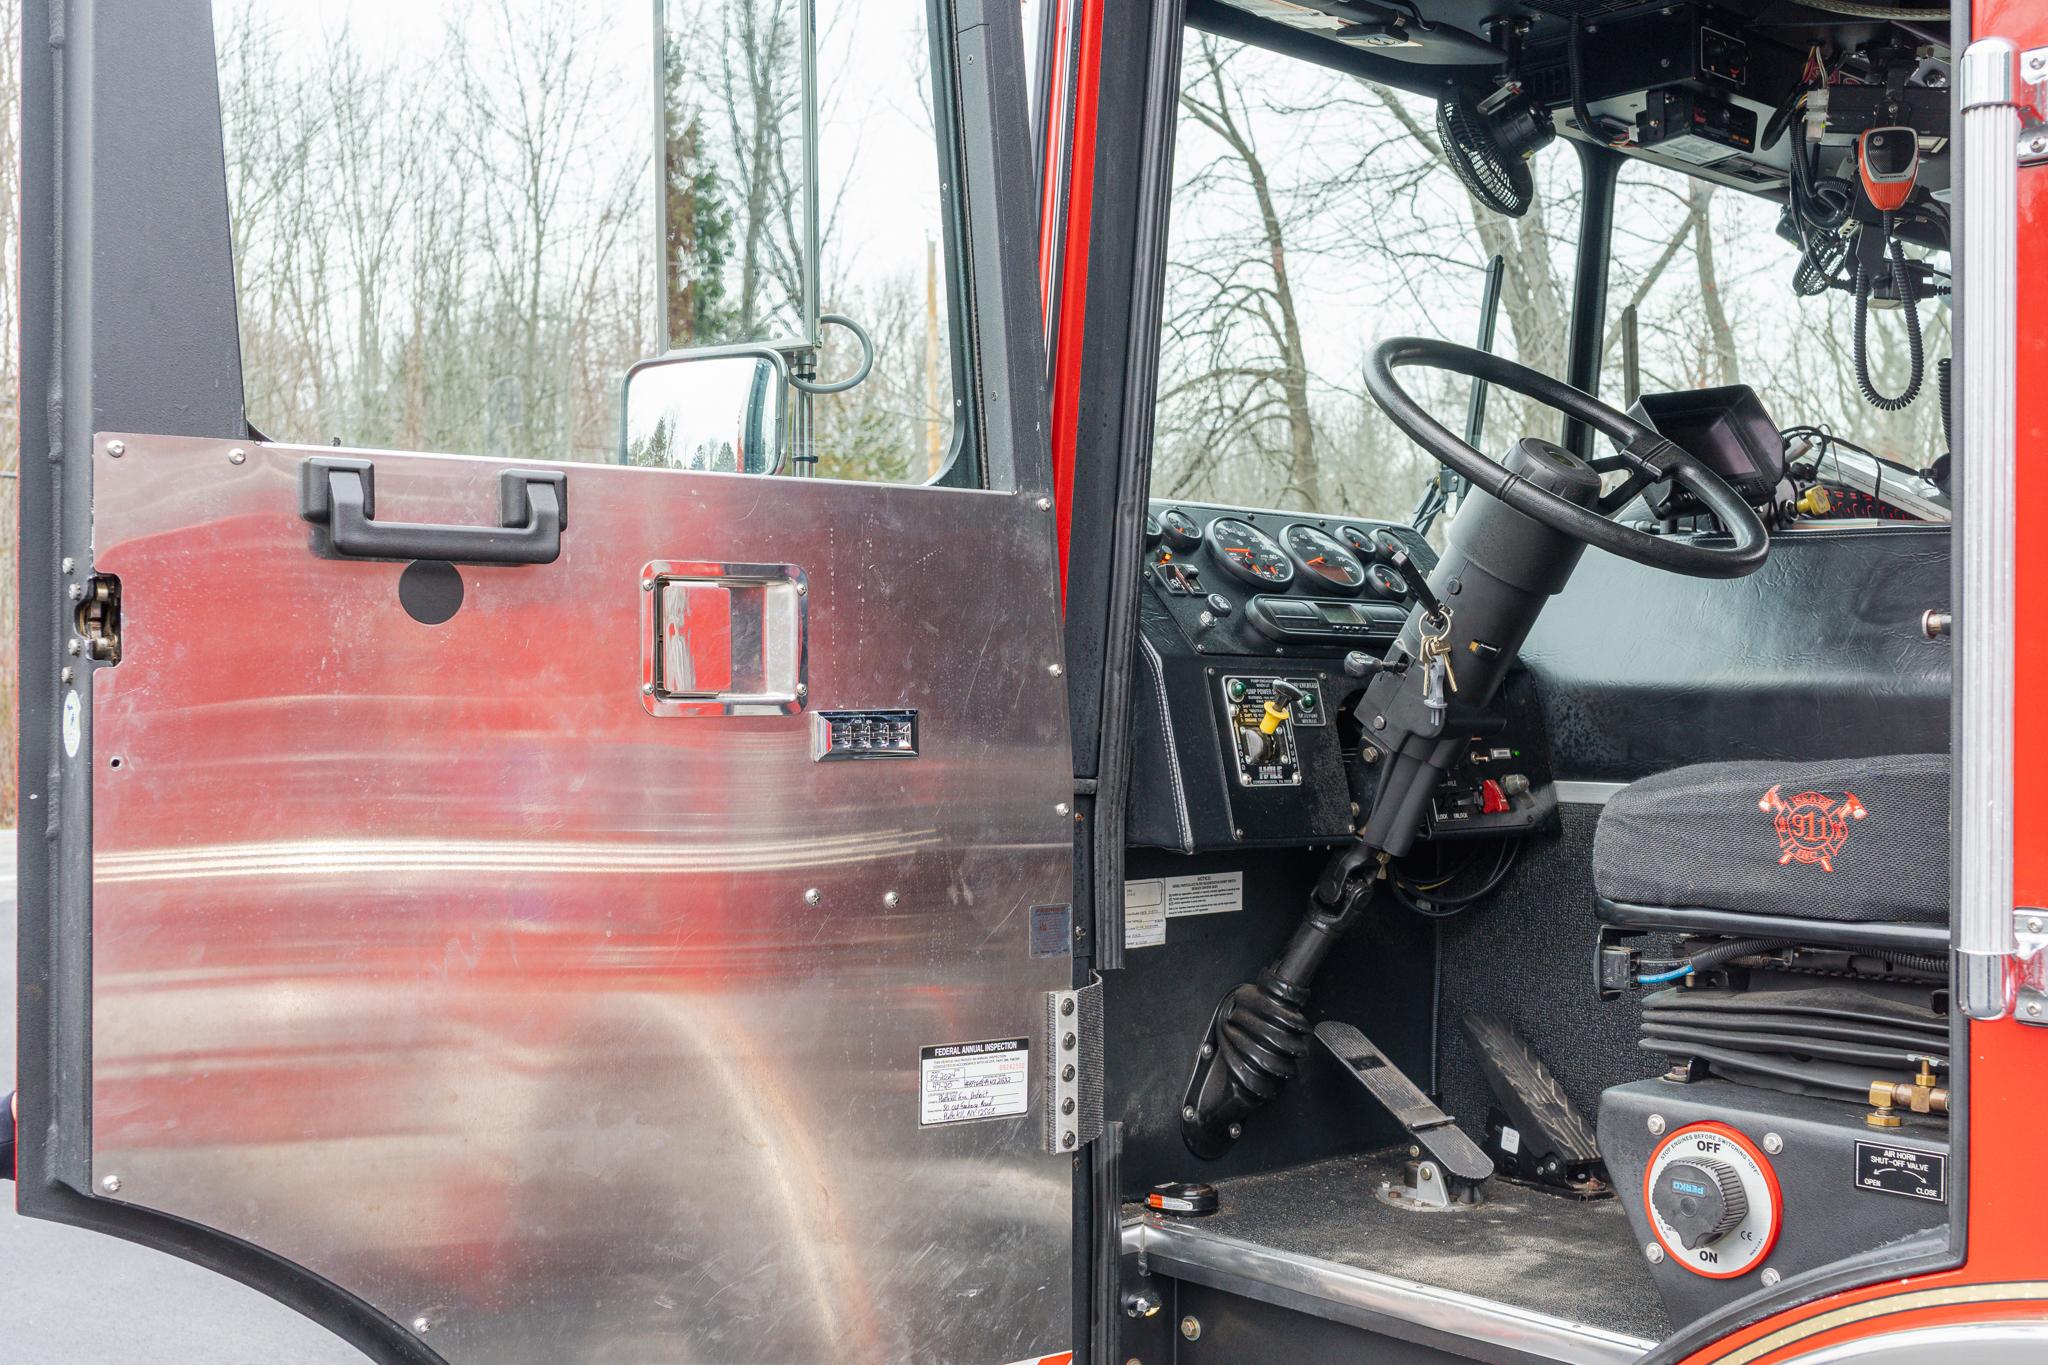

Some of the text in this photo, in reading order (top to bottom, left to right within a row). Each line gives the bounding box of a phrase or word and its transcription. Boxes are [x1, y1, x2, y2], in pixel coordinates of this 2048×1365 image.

[1791, 811, 1830, 842] 911
[935, 1040, 1017, 1057] FEDERAL ANNUAL INSPECTION
[1660, 1147, 1671, 1161] STOP
[1671, 1134, 1693, 1149] ENGINES
[1718, 1137, 1747, 1160] SWITCHING
[1697, 1140, 1721, 1154] OFF
[1884, 1150, 1916, 1162] AIR HORN
[1870, 1155, 1929, 1172] SHUT-OFF VALVE
[1673, 1180, 1704, 1195] PERKO
[1864, 1177, 1881, 1187] OPEN
[1916, 1187, 1938, 1197] CLOSE
[1699, 1250, 1718, 1264] ON
